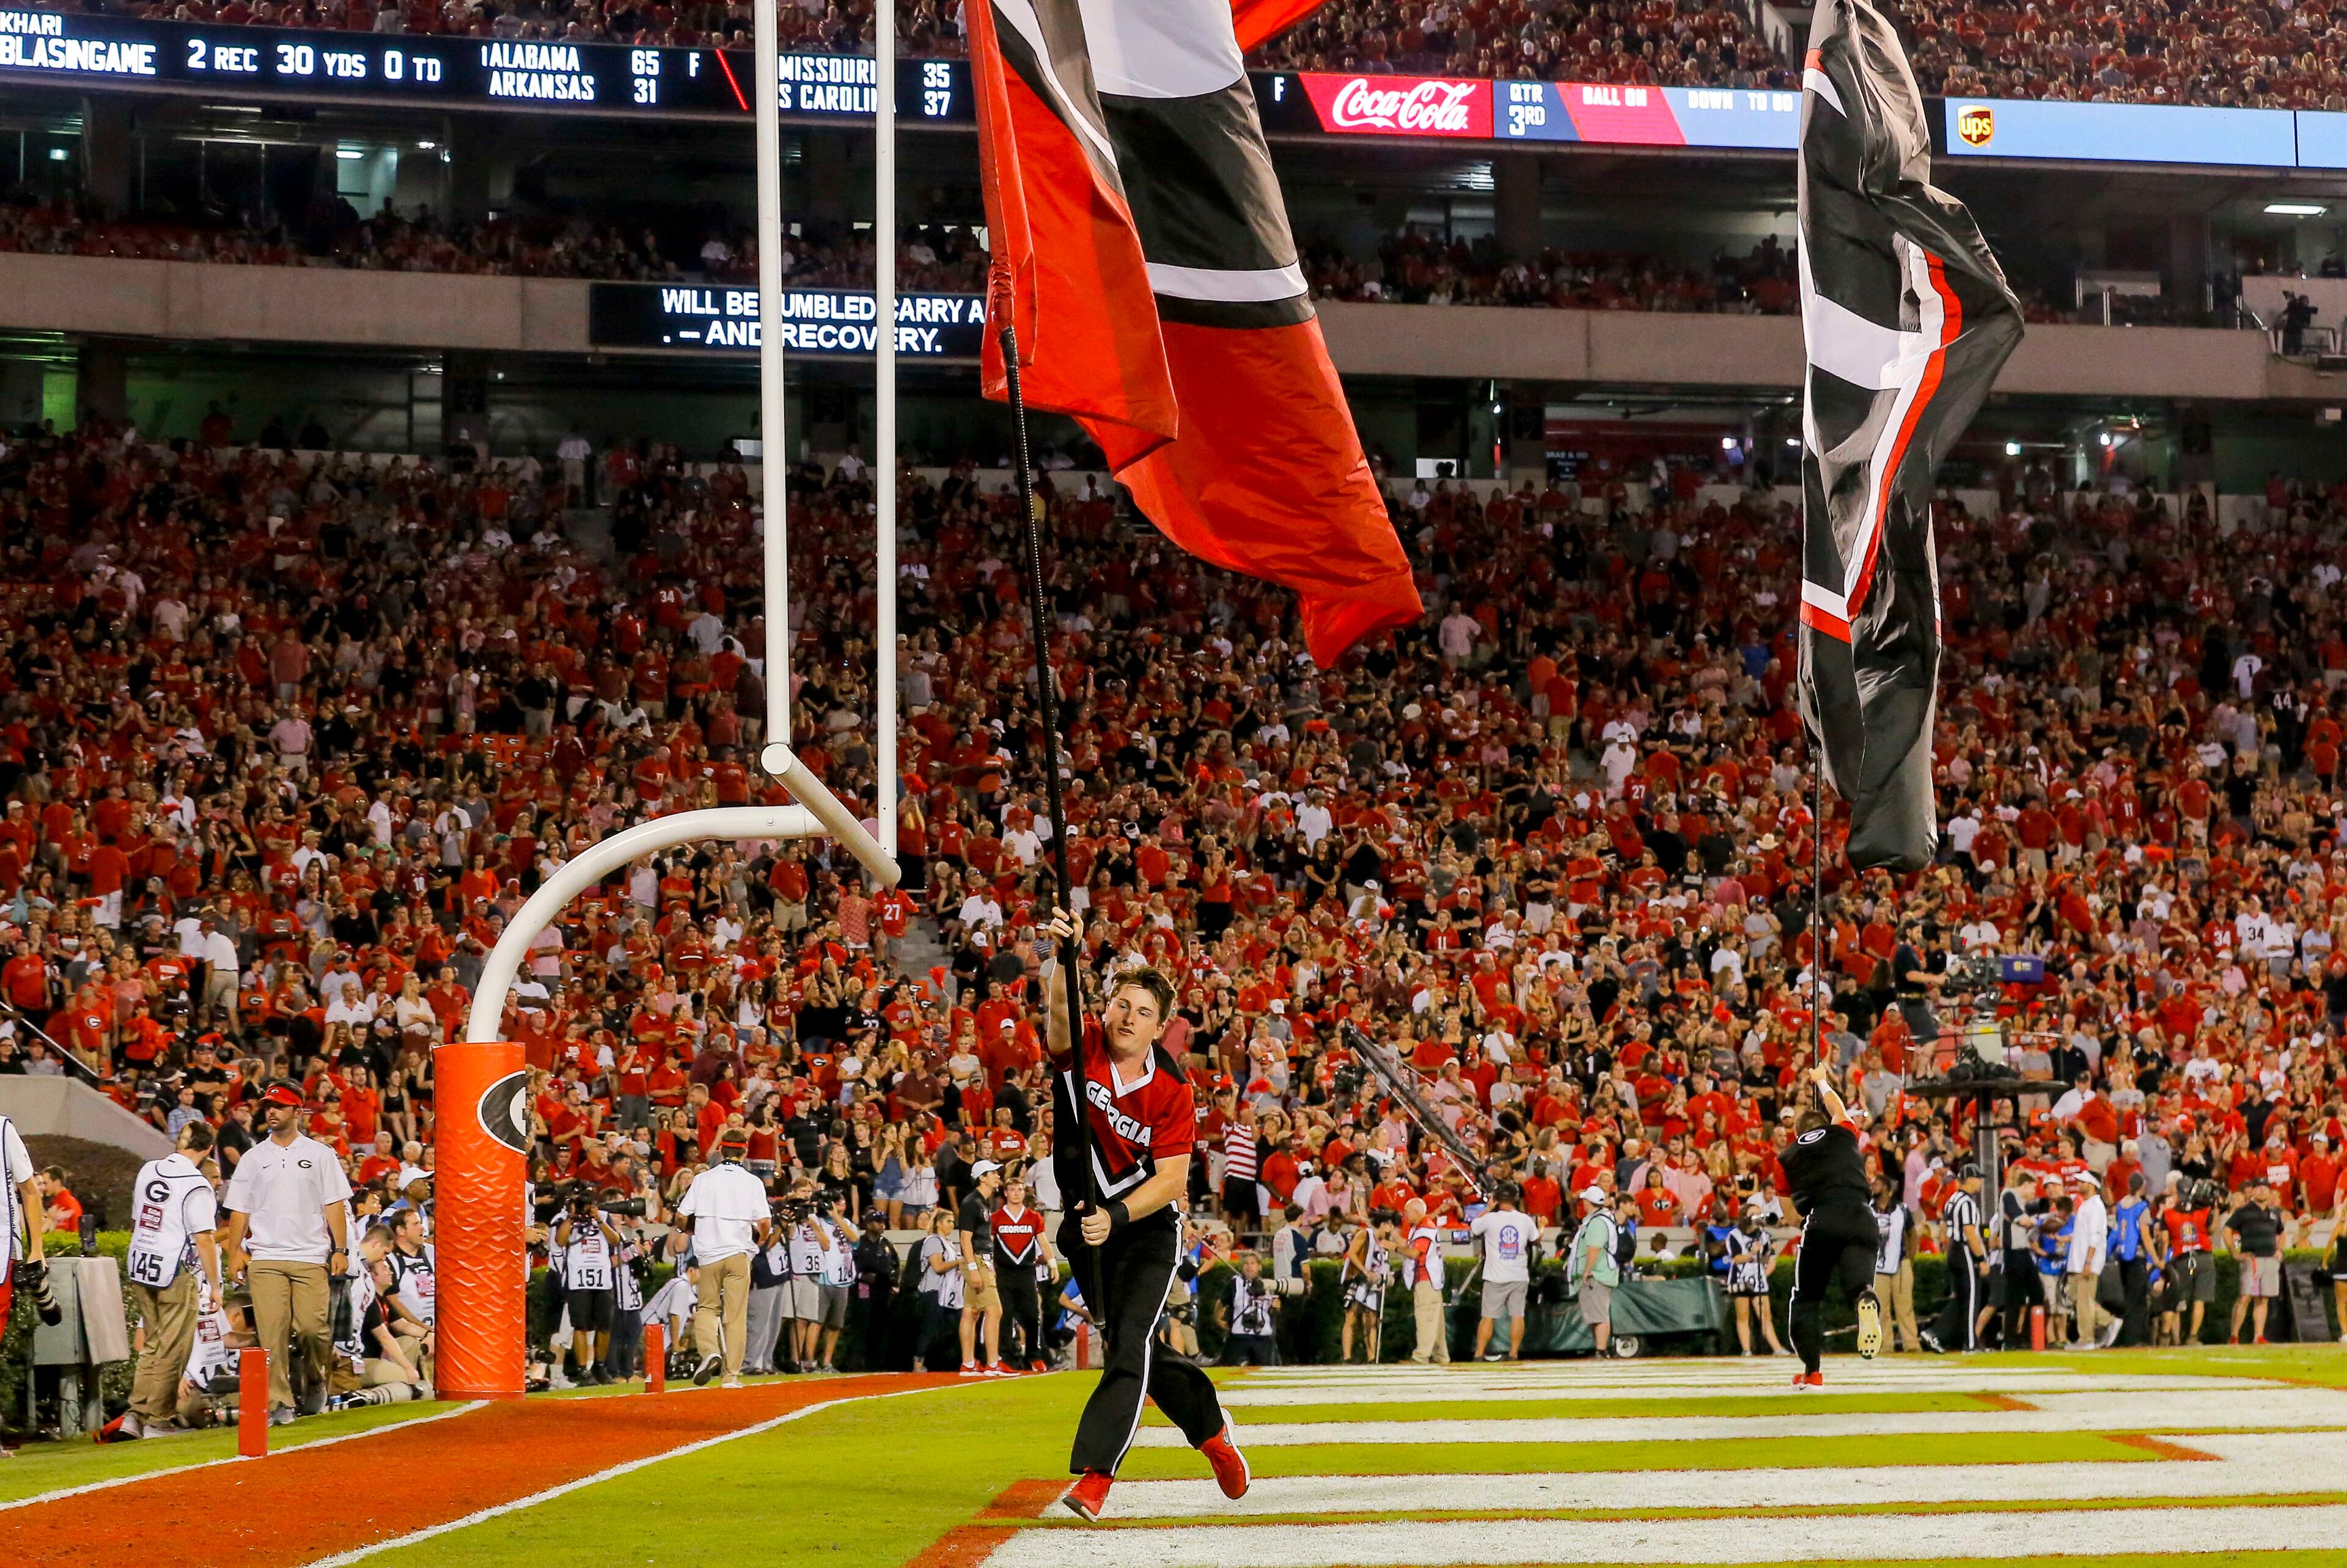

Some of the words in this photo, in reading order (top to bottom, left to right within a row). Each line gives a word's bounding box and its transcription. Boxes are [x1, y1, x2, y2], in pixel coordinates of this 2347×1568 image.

[0, 12, 62, 36] KHARI
[0, 35, 156, 75] BLASINGAME
[188, 39, 206, 69] 2
[214, 46, 259, 71] REC
[276, 44, 314, 75] 30
[323, 53, 366, 78] YDS
[384, 50, 403, 79] 0
[412, 57, 441, 82] TD
[631, 50, 659, 75] 65
[689, 52, 700, 77] F
[779, 56, 876, 84] MISSOURI
[924, 62, 950, 88] 35
[489, 70, 595, 100] ARKANSAS
[634, 78, 656, 103] 31
[1274, 77, 1285, 101] F
[1510, 83, 1543, 103] QTR
[1582, 86, 1620, 106] BALL
[1625, 88, 1647, 107] ON
[779, 84, 792, 109] S
[800, 84, 897, 113] CAROLI
[925, 90, 950, 117] 37
[1332, 78, 1476, 130] Coca-Cola
[1688, 90, 1733, 110] DOWN
[1747, 92, 1768, 111] TO
[1508, 104, 1546, 136] 3RD
[1961, 117, 1991, 141] ups
[662, 288, 720, 315] WILL
[726, 291, 758, 316] BE
[780, 293, 876, 320] UMBLED
[705, 320, 762, 346] AND
[659, 590, 675, 603] 34
[2272, 692, 2292, 710] 44
[1632, 785, 1645, 799] 27
[2124, 802, 2133, 818] 11
[884, 904, 901, 921] 27
[1437, 936, 1447, 950] 11
[2248, 927, 2264, 942] 34
[1586, 1055, 1594, 1074] 1
[1086, 1080, 1151, 1147] GERGIA
[298, 1159, 313, 1168] G
[145, 1180, 171, 1203] G
[998, 1225, 1034, 1234] GEORGIA
[131, 1250, 164, 1283] 145
[806, 1255, 820, 1272] 36
[578, 1269, 603, 1288] 151
